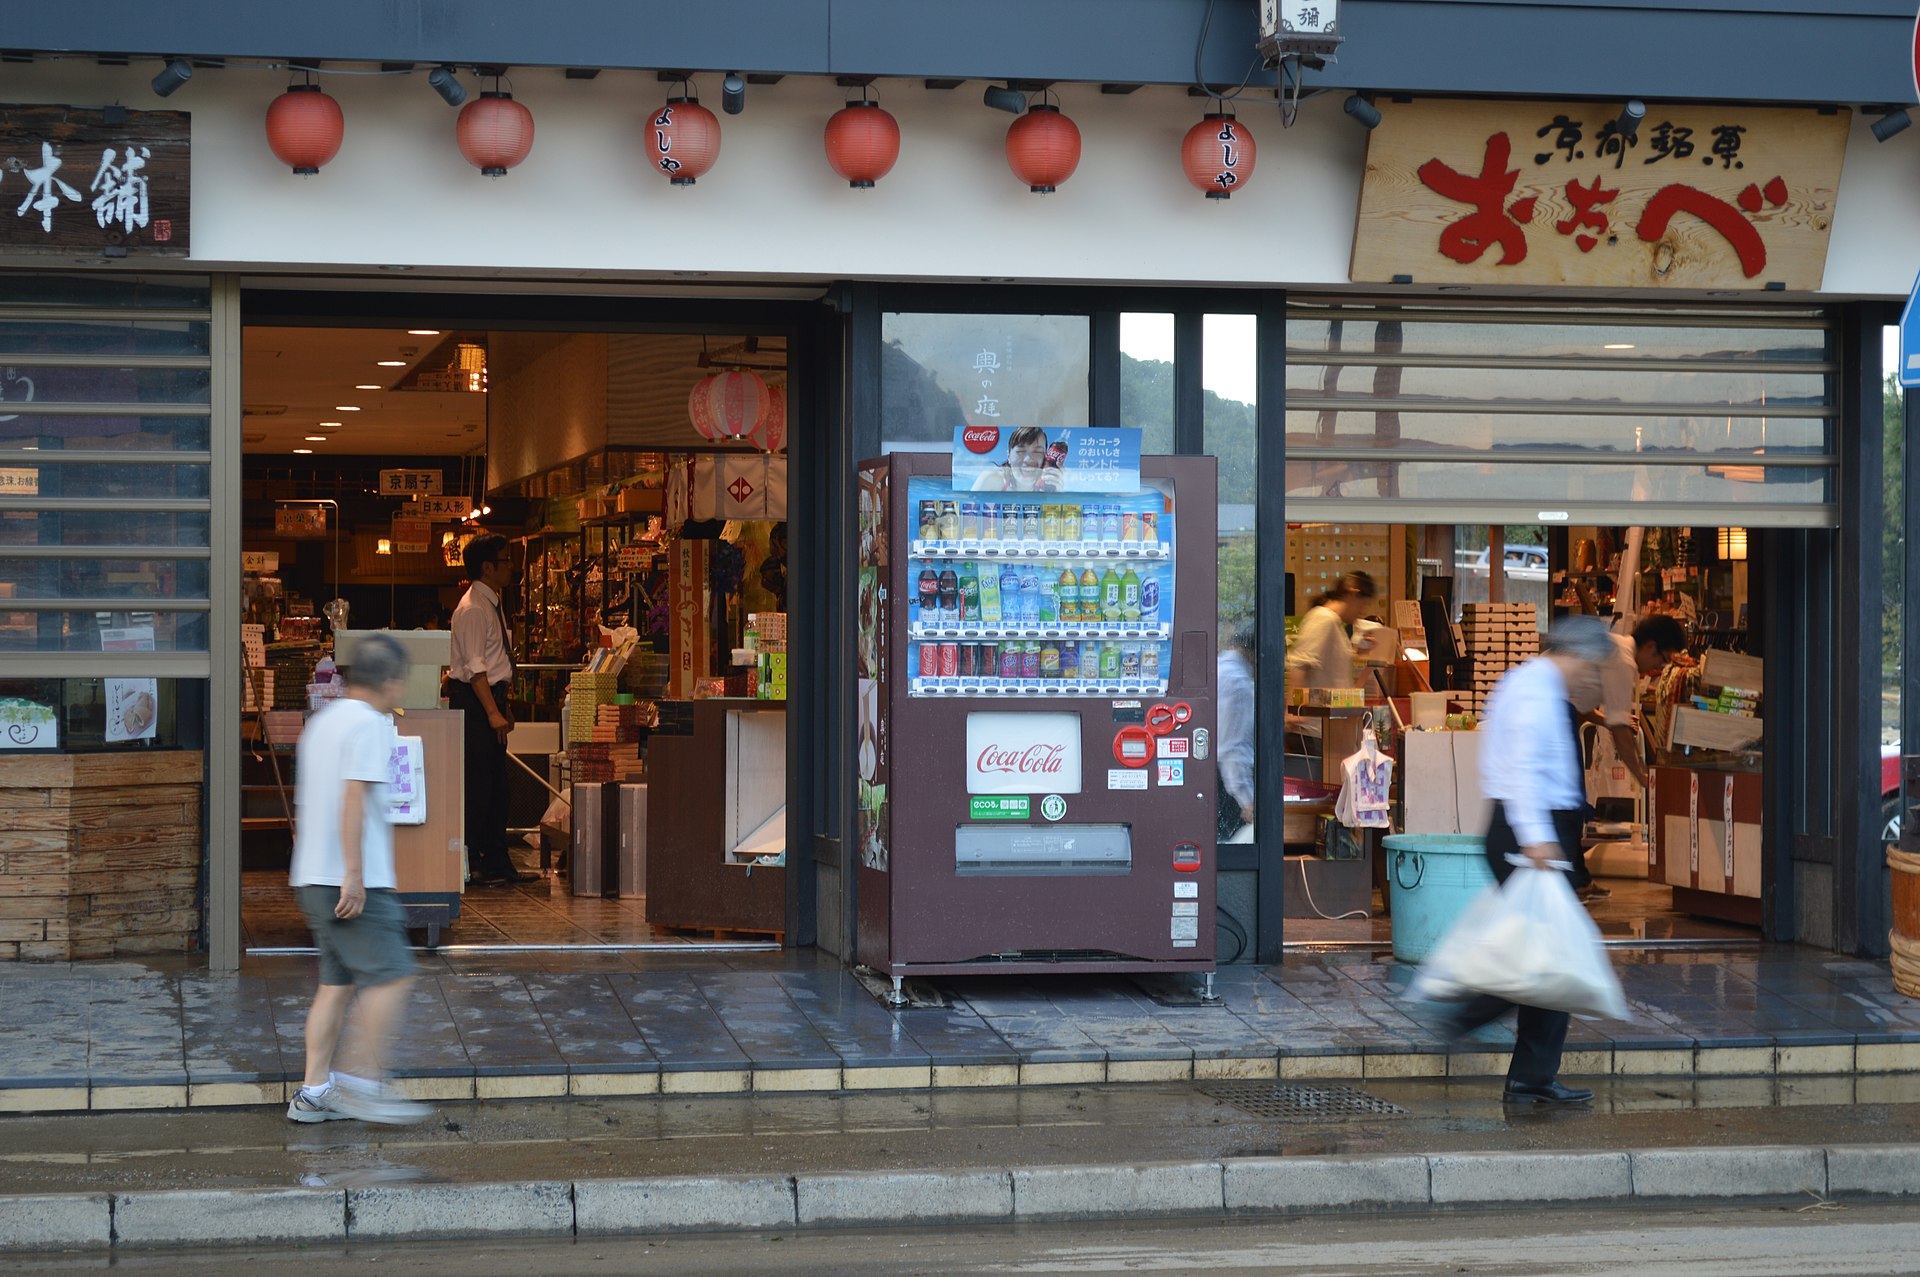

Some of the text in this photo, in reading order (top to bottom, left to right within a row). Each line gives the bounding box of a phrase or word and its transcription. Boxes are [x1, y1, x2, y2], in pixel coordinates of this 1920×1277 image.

[655, 108, 681, 174] よしや
[1534, 115, 1746, 169] 京都銘菓
[1215, 123, 1237, 188] よしや
[0, 141, 151, 234] 本舗
[1417, 131, 1788, 278] おたべ
[964, 430, 998, 442] Coca-Cola
[1079, 437, 1121, 447] コカ・コーラ
[1078, 447, 1120, 457] のおいしさ
[1078, 458, 1120, 471] ホントに
[389, 474, 433, 490] 京扇子
[423, 501, 465, 513] 日本人形
[976, 743, 1068, 774] Coca-Cola
